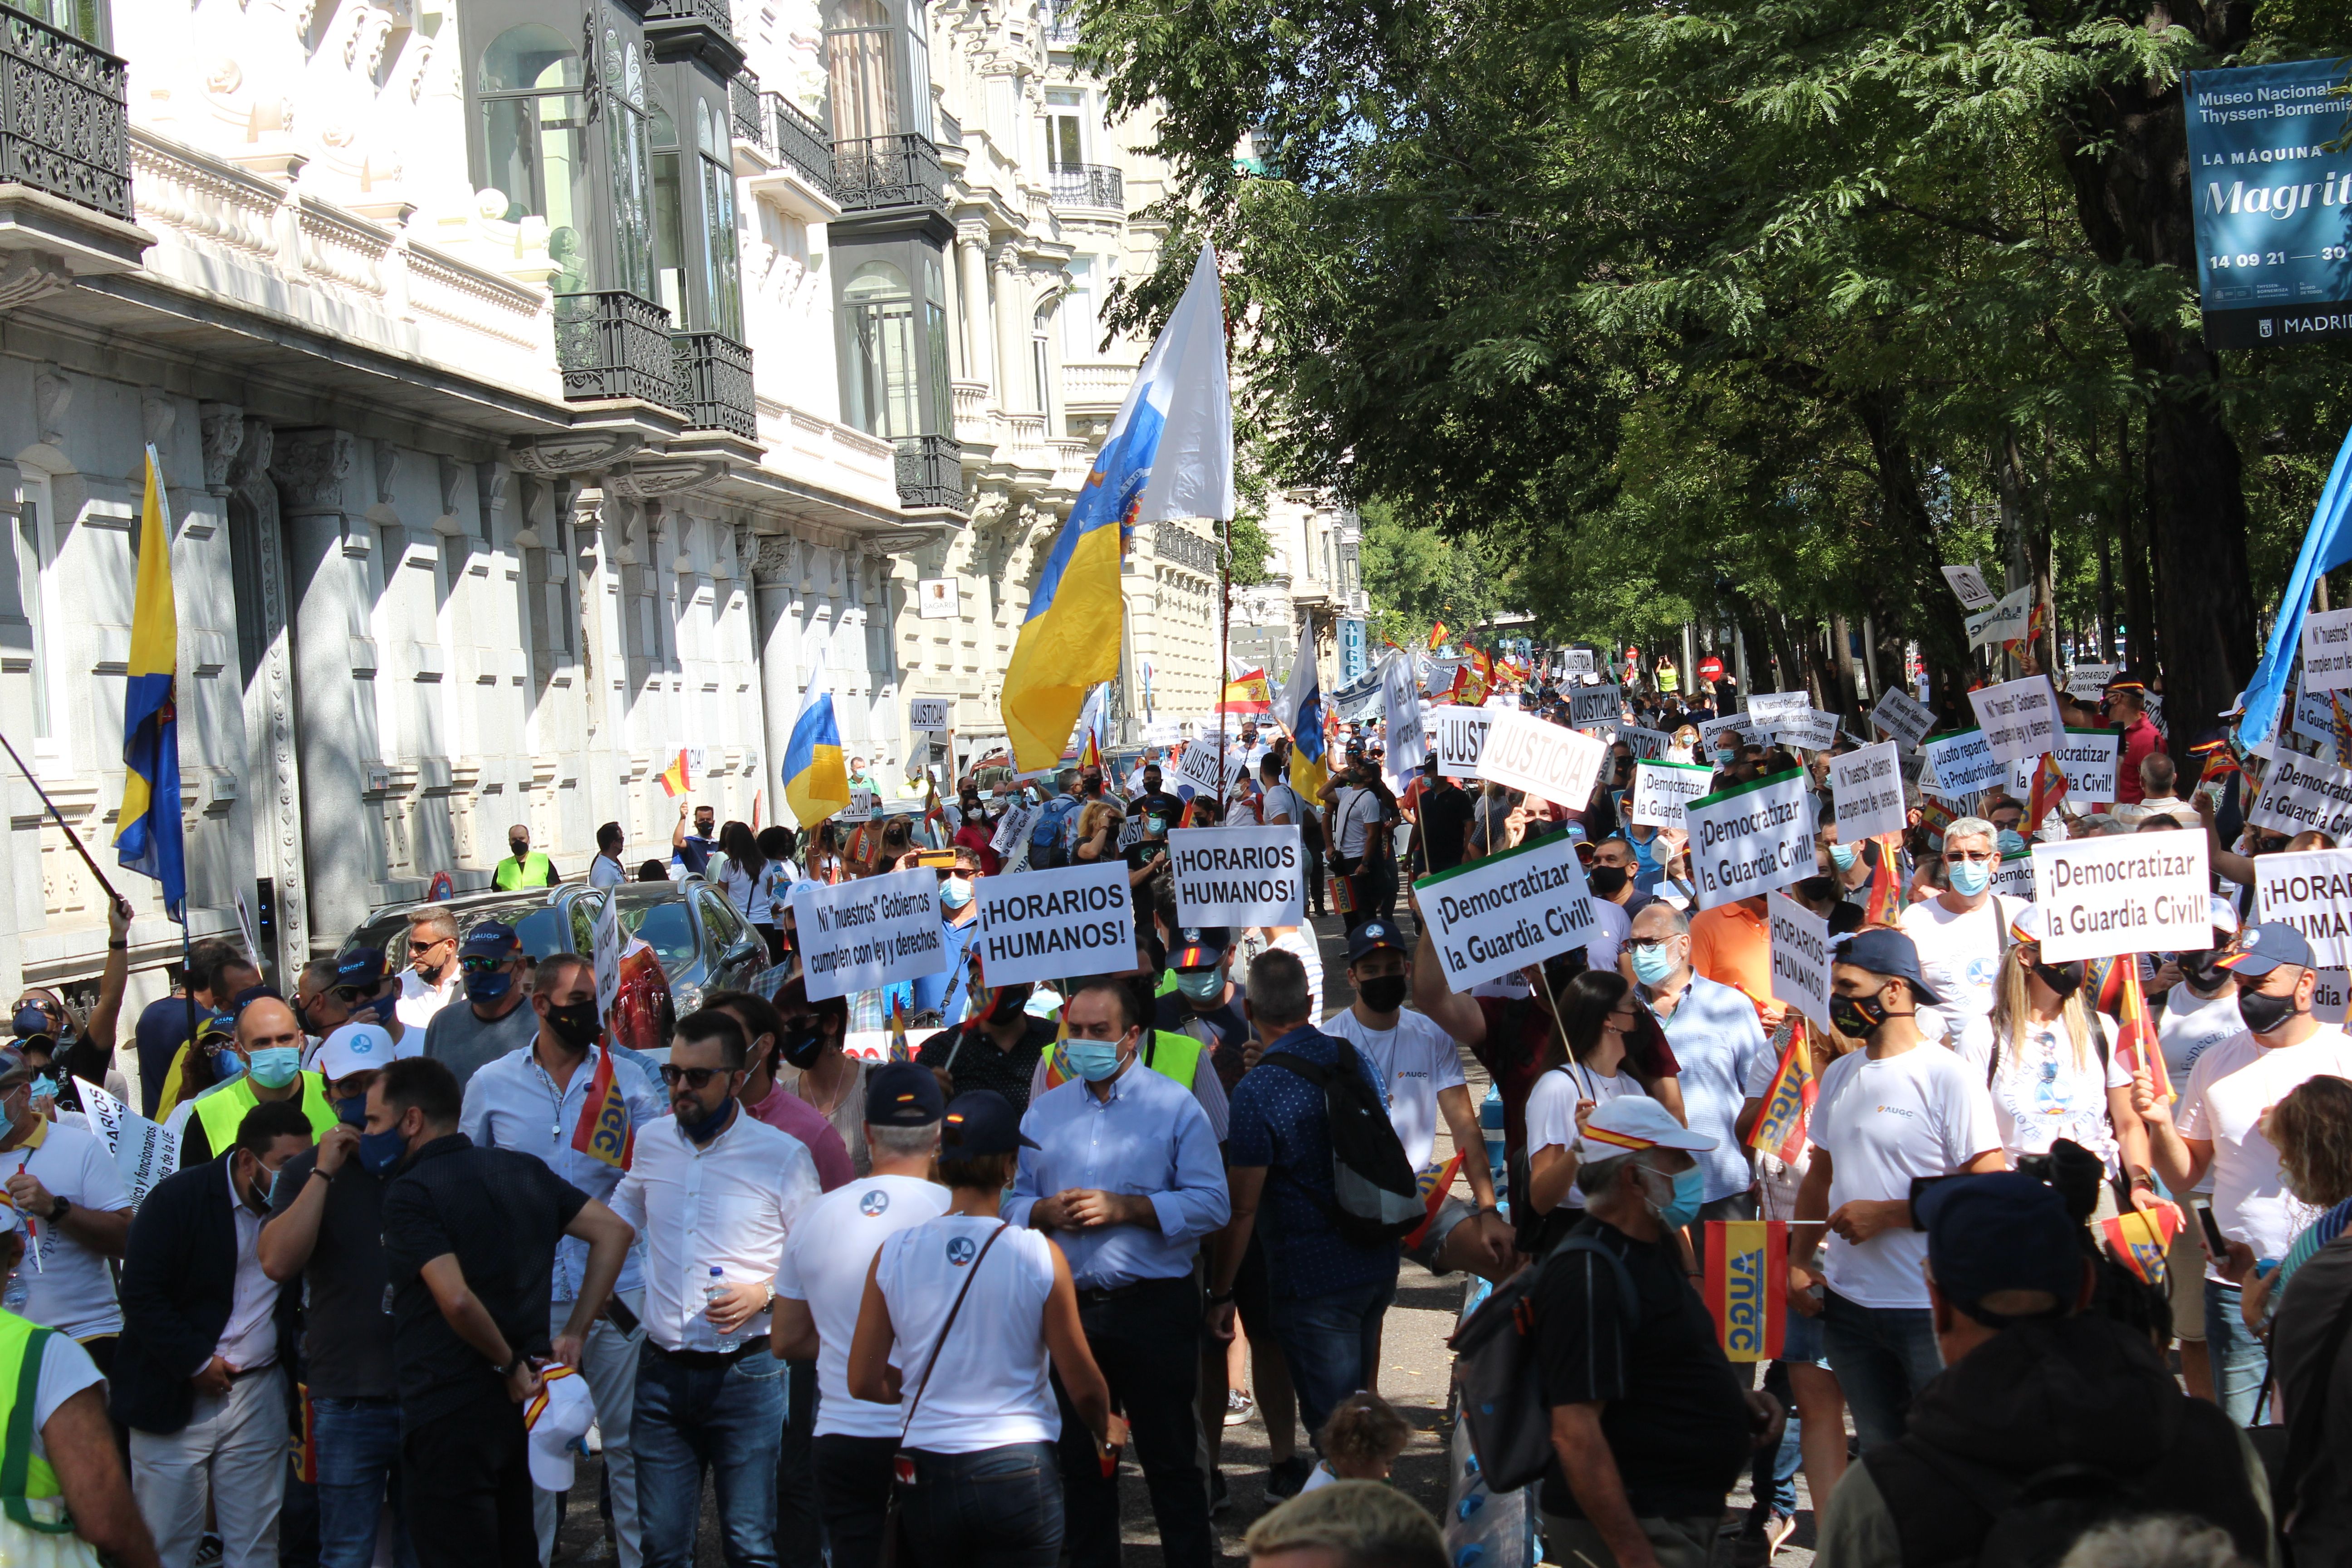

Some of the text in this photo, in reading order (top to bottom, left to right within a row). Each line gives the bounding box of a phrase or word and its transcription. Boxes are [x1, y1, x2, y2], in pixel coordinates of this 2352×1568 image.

[2199, 81, 2332, 106] Museo Nacional
[2202, 146, 2322, 166] LA MÁQUINA
[2210, 246, 2346, 269] 14 09 21 30
[2284, 314, 2352, 333] MADRI
[924, 602, 956, 610] SAGARDI
[2313, 622, 2349, 645] Ni "nuestros"
[1345, 621, 1358, 677] AUGC
[1566, 655, 1592, 669] ¡JUSTICIA!
[2308, 654, 2332, 677] cumplen
[2334, 657, 2345, 669] con
[2071, 671, 2109, 682] ¡HORARIOS
[912, 704, 945, 724] ¡JUSTICIA!
[1352, 705, 1386, 720] Derech
[1573, 692, 1620, 721] ¡JUSTICIA!
[1757, 699, 1805, 711] Ni "nuestros" Gobiernos
[1755, 716, 1774, 726] cumplen
[1791, 713, 1811, 722] derechos.
[1813, 717, 1833, 730] Gobiernos
[1877, 706, 1892, 723] cumplen
[1891, 717, 1899, 725] con
[1904, 725, 1920, 742] derechos.
[1911, 710, 1928, 729] Gobiernos
[2298, 705, 2336, 735] la Guardi
[1705, 743, 1712, 753] la
[1813, 732, 1831, 745] derechos.
[1488, 720, 1595, 794] ¡JUSTICIA!
[1933, 745, 1960, 770] ¡Justo
[1642, 774, 1704, 796] ¡Democratizar
[1940, 774, 1951, 789] la
[2017, 771, 2027, 788] la
[2083, 773, 2111, 792] Civil!
[1638, 800, 1682, 819] la Guardia
[1838, 797, 1861, 823] cumplen
[1860, 798, 1871, 814] con
[2260, 790, 2273, 811] la
[2276, 795, 2328, 829] Guardia
[995, 809, 1020, 848] ¡Democratizar
[1006, 827, 1022, 848] Guardia
[1018, 813, 1031, 828] Civil!
[1700, 799, 1800, 856] ¡Democratizar
[1176, 846, 1295, 877] ¡HORARIOS
[1700, 834, 1812, 893] la Guardia Civil!
[2049, 849, 2195, 898] ¡Democratizar
[1182, 880, 1295, 904] HUMANOS!
[1438, 863, 1570, 935] ¡Democratizar
[2263, 873, 2352, 911] ¡HORA
[817, 892, 930, 933] Ni "nuestros" Gobiernos
[982, 884, 1125, 932] ¡HORARIOS
[2047, 895, 2205, 937] la Guardia Civil!
[989, 920, 1126, 961] HUMANOS!
[1445, 897, 1595, 973] la Guardia Civil!
[1770, 914, 1824, 966] ¡HORARIOS
[811, 928, 940, 976] cumplen con ley y derechos.
[1774, 949, 1824, 1004] HUMANOS!
[1884, 1105, 1913, 1117] AUGC
[134, 1125, 158, 1189] y funcionarios,
[160, 1129, 175, 1166] de la UE
